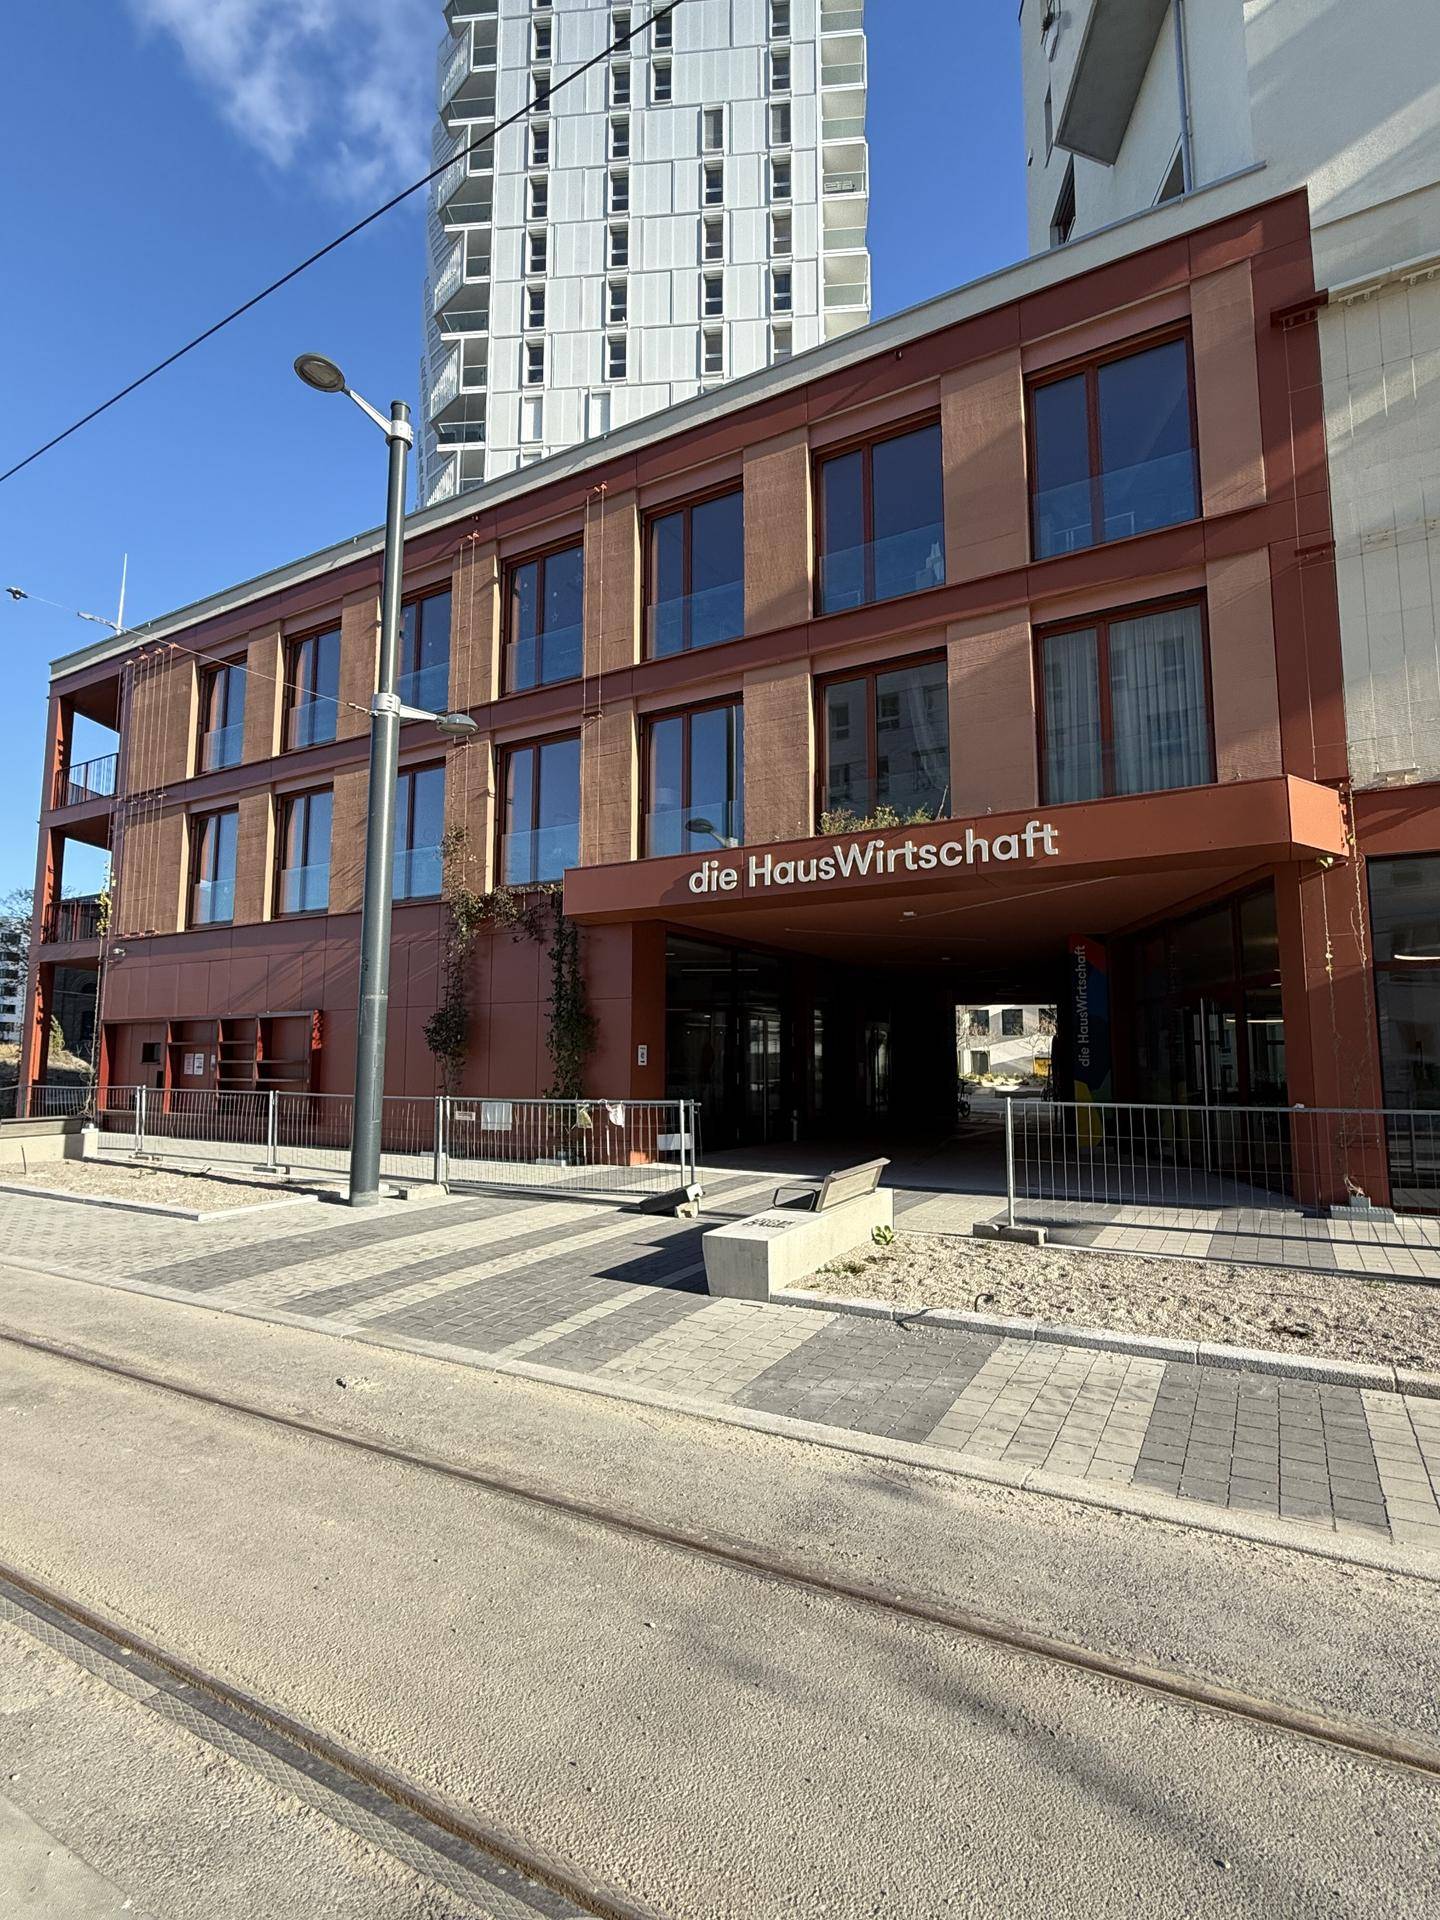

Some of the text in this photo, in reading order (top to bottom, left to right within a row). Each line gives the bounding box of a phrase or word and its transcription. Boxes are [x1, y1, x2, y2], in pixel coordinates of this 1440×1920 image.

[688, 820, 1059, 893] die HausWirtschaft
[1074, 945, 1090, 1067] die HausWirtschaft
